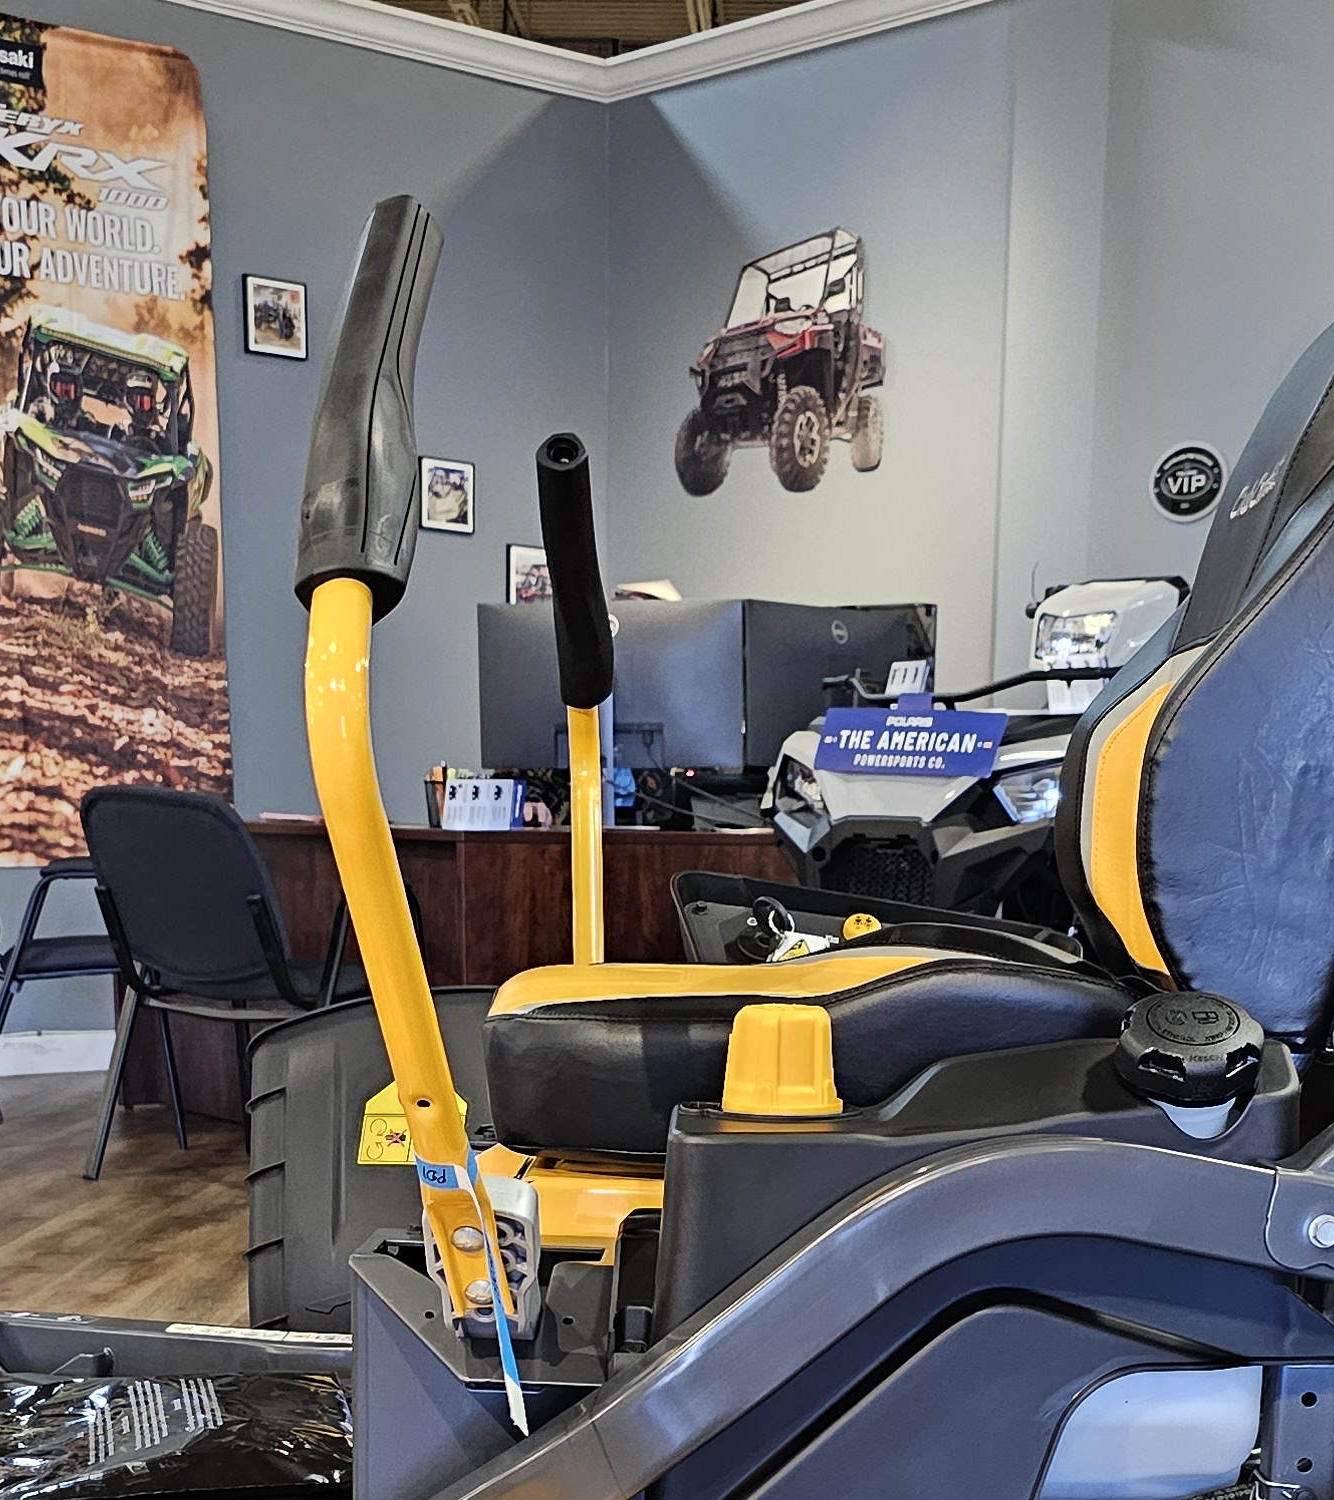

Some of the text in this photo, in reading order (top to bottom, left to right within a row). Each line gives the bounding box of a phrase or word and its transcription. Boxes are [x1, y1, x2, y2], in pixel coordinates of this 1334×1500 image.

[97, 186, 167, 210] 1000
[65, 206, 161, 254] WORLD.
[39, 247, 186, 300] ADVENTURE.
[1168, 474, 1206, 494] VIP
[839, 729, 977, 753] THE AMERICAN
[853, 753, 945, 769] POWERSPORTS CO.
